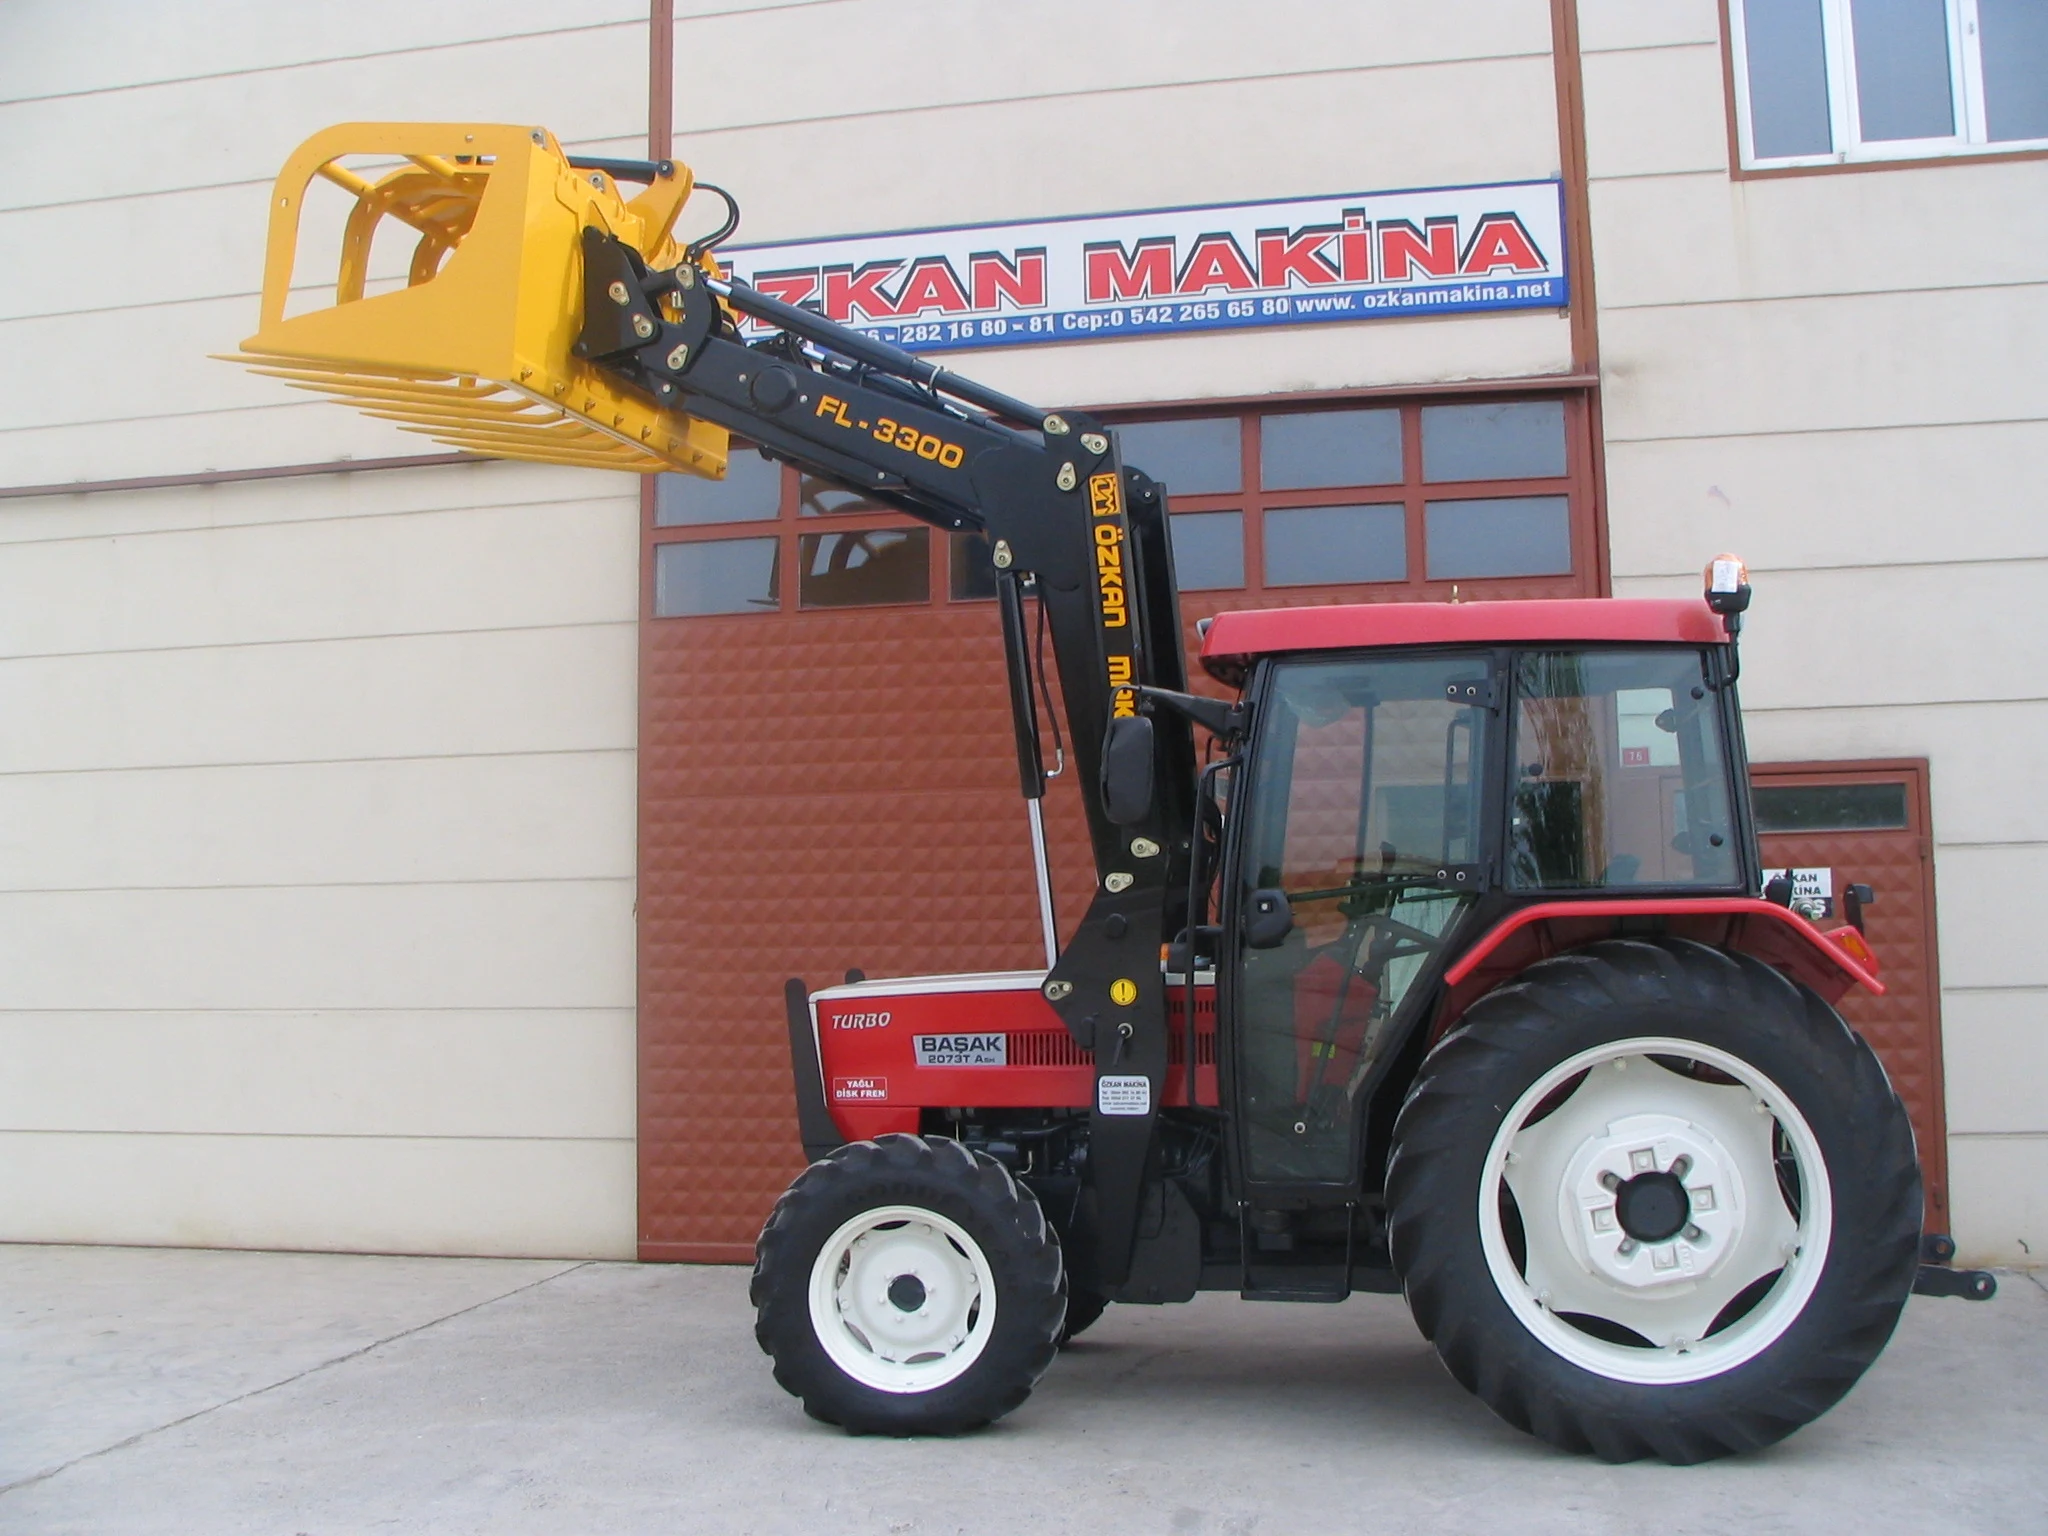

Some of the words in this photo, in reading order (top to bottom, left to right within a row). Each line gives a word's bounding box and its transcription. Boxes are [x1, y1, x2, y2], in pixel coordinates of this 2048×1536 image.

[718, 246, 1047, 331] ZKAN
[1084, 208, 1549, 304] MAKİNA
[902, 326, 941, 343] 282
[948, 323, 973, 341] 16
[981, 319, 1006, 336] 80
[1030, 315, 1054, 333] 81
[1131, 307, 1173, 325] 542
[1179, 304, 1219, 321] 265
[1228, 301, 1254, 318] 65
[1262, 298, 1287, 315] 80
[1296, 295, 1355, 313] www.
[1364, 281, 1551, 308] ozkanmakina.net
[816, 395, 852, 428] FL
[873, 418, 964, 469] 3300
[831, 1012, 891, 1030] TURBO
[922, 1036, 1001, 1054] BAŞAK
[928, 1055, 970, 1064] 2073T
[860, 1089, 885, 1098] FREN
